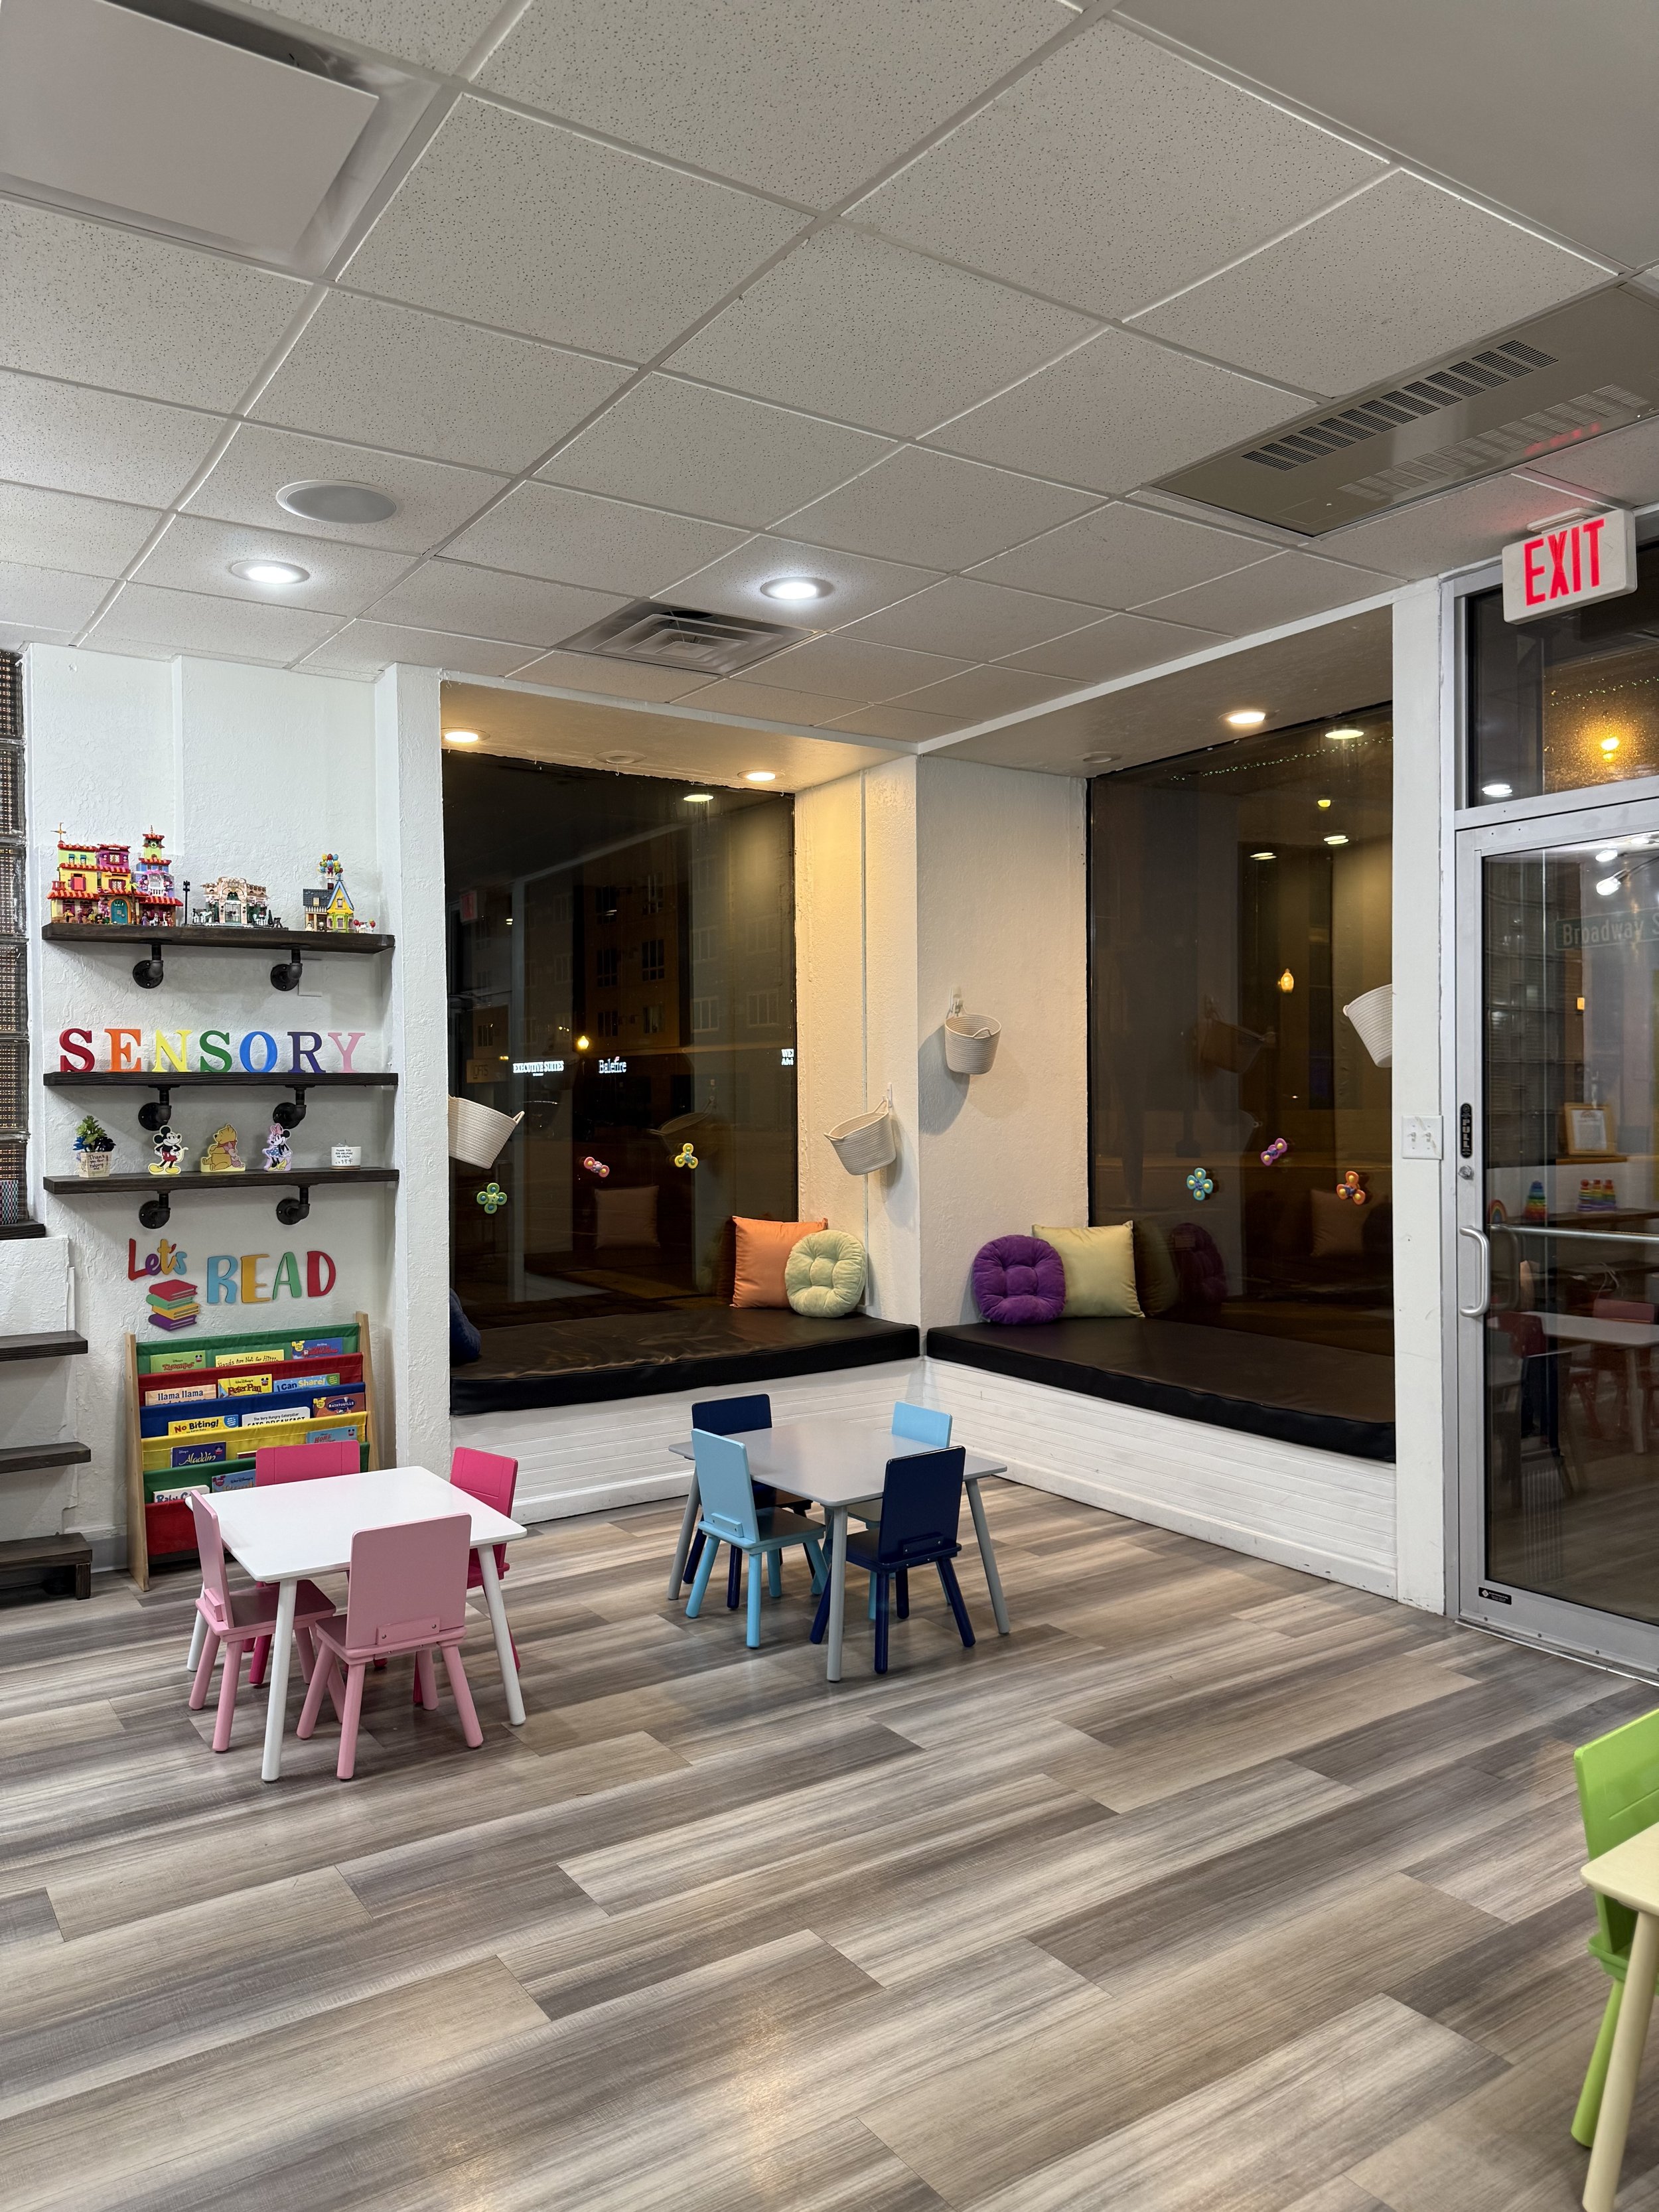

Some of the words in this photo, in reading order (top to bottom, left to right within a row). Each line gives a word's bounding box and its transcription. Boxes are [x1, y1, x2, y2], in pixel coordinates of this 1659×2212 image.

[1524, 518, 1606, 607] EXIT
[1563, 919, 1644, 946] Broadway
[59, 1027, 366, 1073] SENSORY
[512, 1062, 543, 1073] EXECUTIVE
[544, 1061, 564, 1072] SUITES
[599, 1057, 627, 1074] Balefire
[1462, 1119, 1471, 1147] PULL
[128, 1238, 187, 1281] Let's
[207, 1251, 336, 1304] READ
[228, 1386, 247, 1396] Peter
[247, 1384, 261, 1392] Pan
[298, 1378, 325, 1387] Share!
[174, 1425, 186, 1434] No
[189, 1420, 218, 1430] Biting!
[179, 1451, 216, 1465] Aladdin
